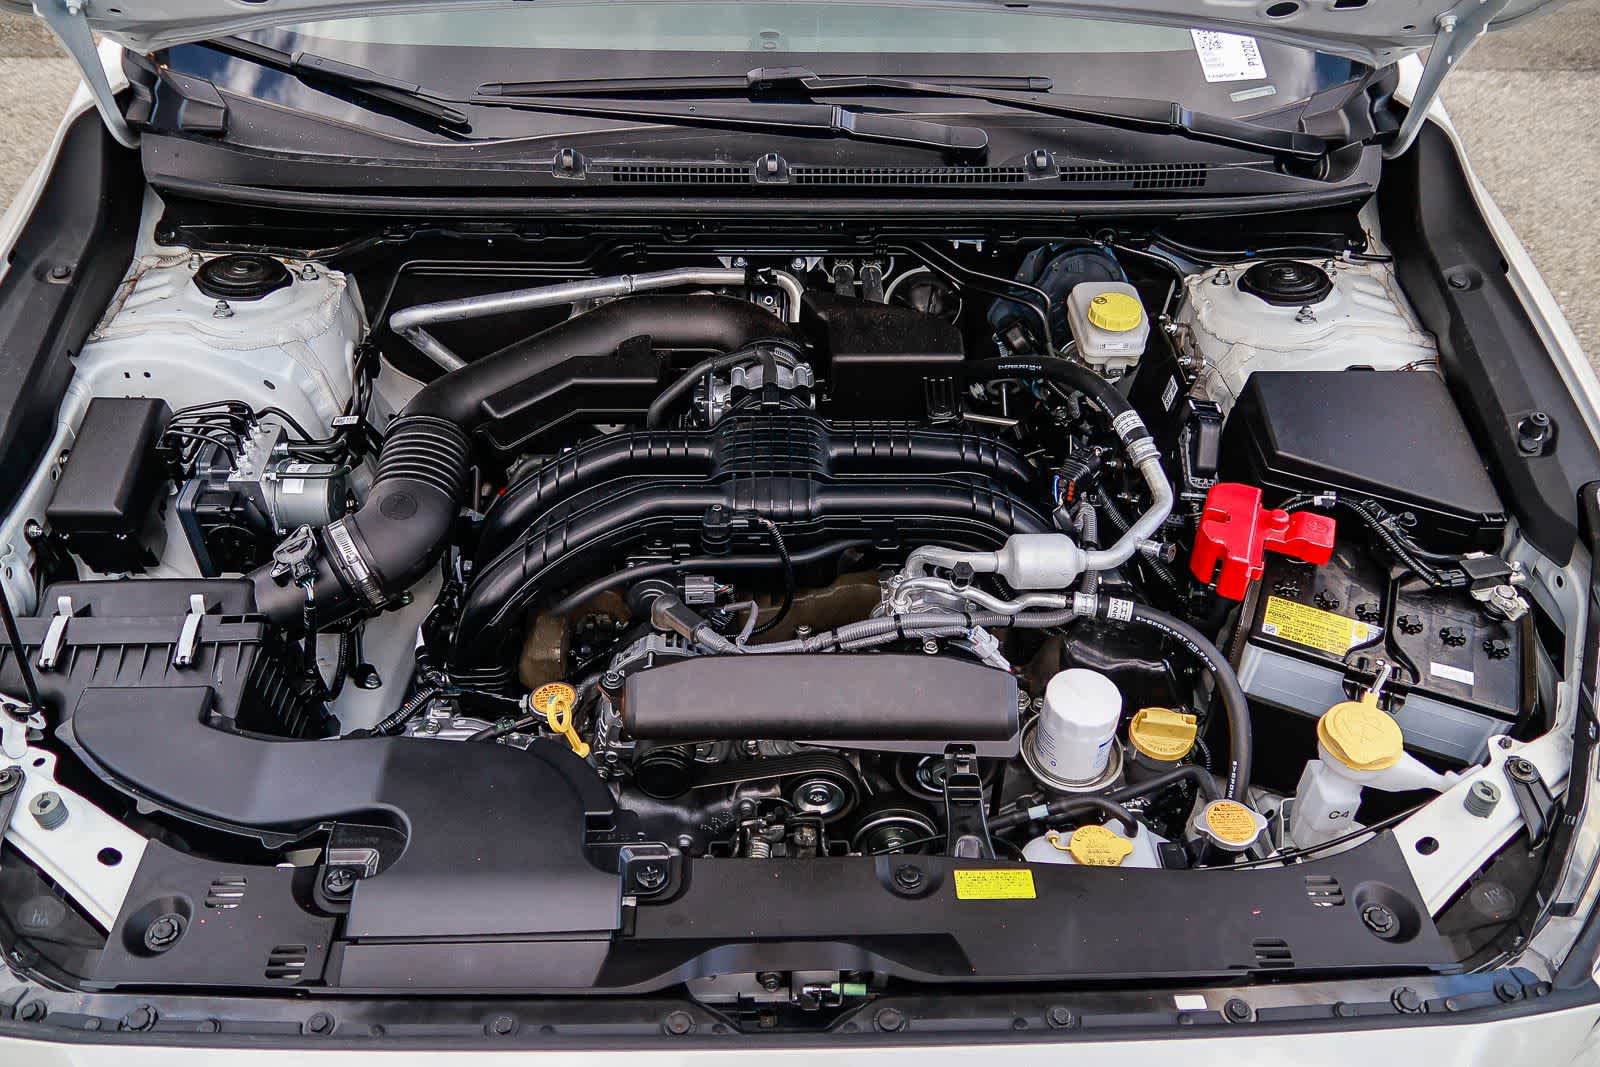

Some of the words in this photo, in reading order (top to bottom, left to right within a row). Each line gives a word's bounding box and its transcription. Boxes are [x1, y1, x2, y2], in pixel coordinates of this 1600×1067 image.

[1270, 597, 1294, 607] DANGER
[1267, 610, 1291, 620] POISON
[1328, 810, 1350, 820] C4
